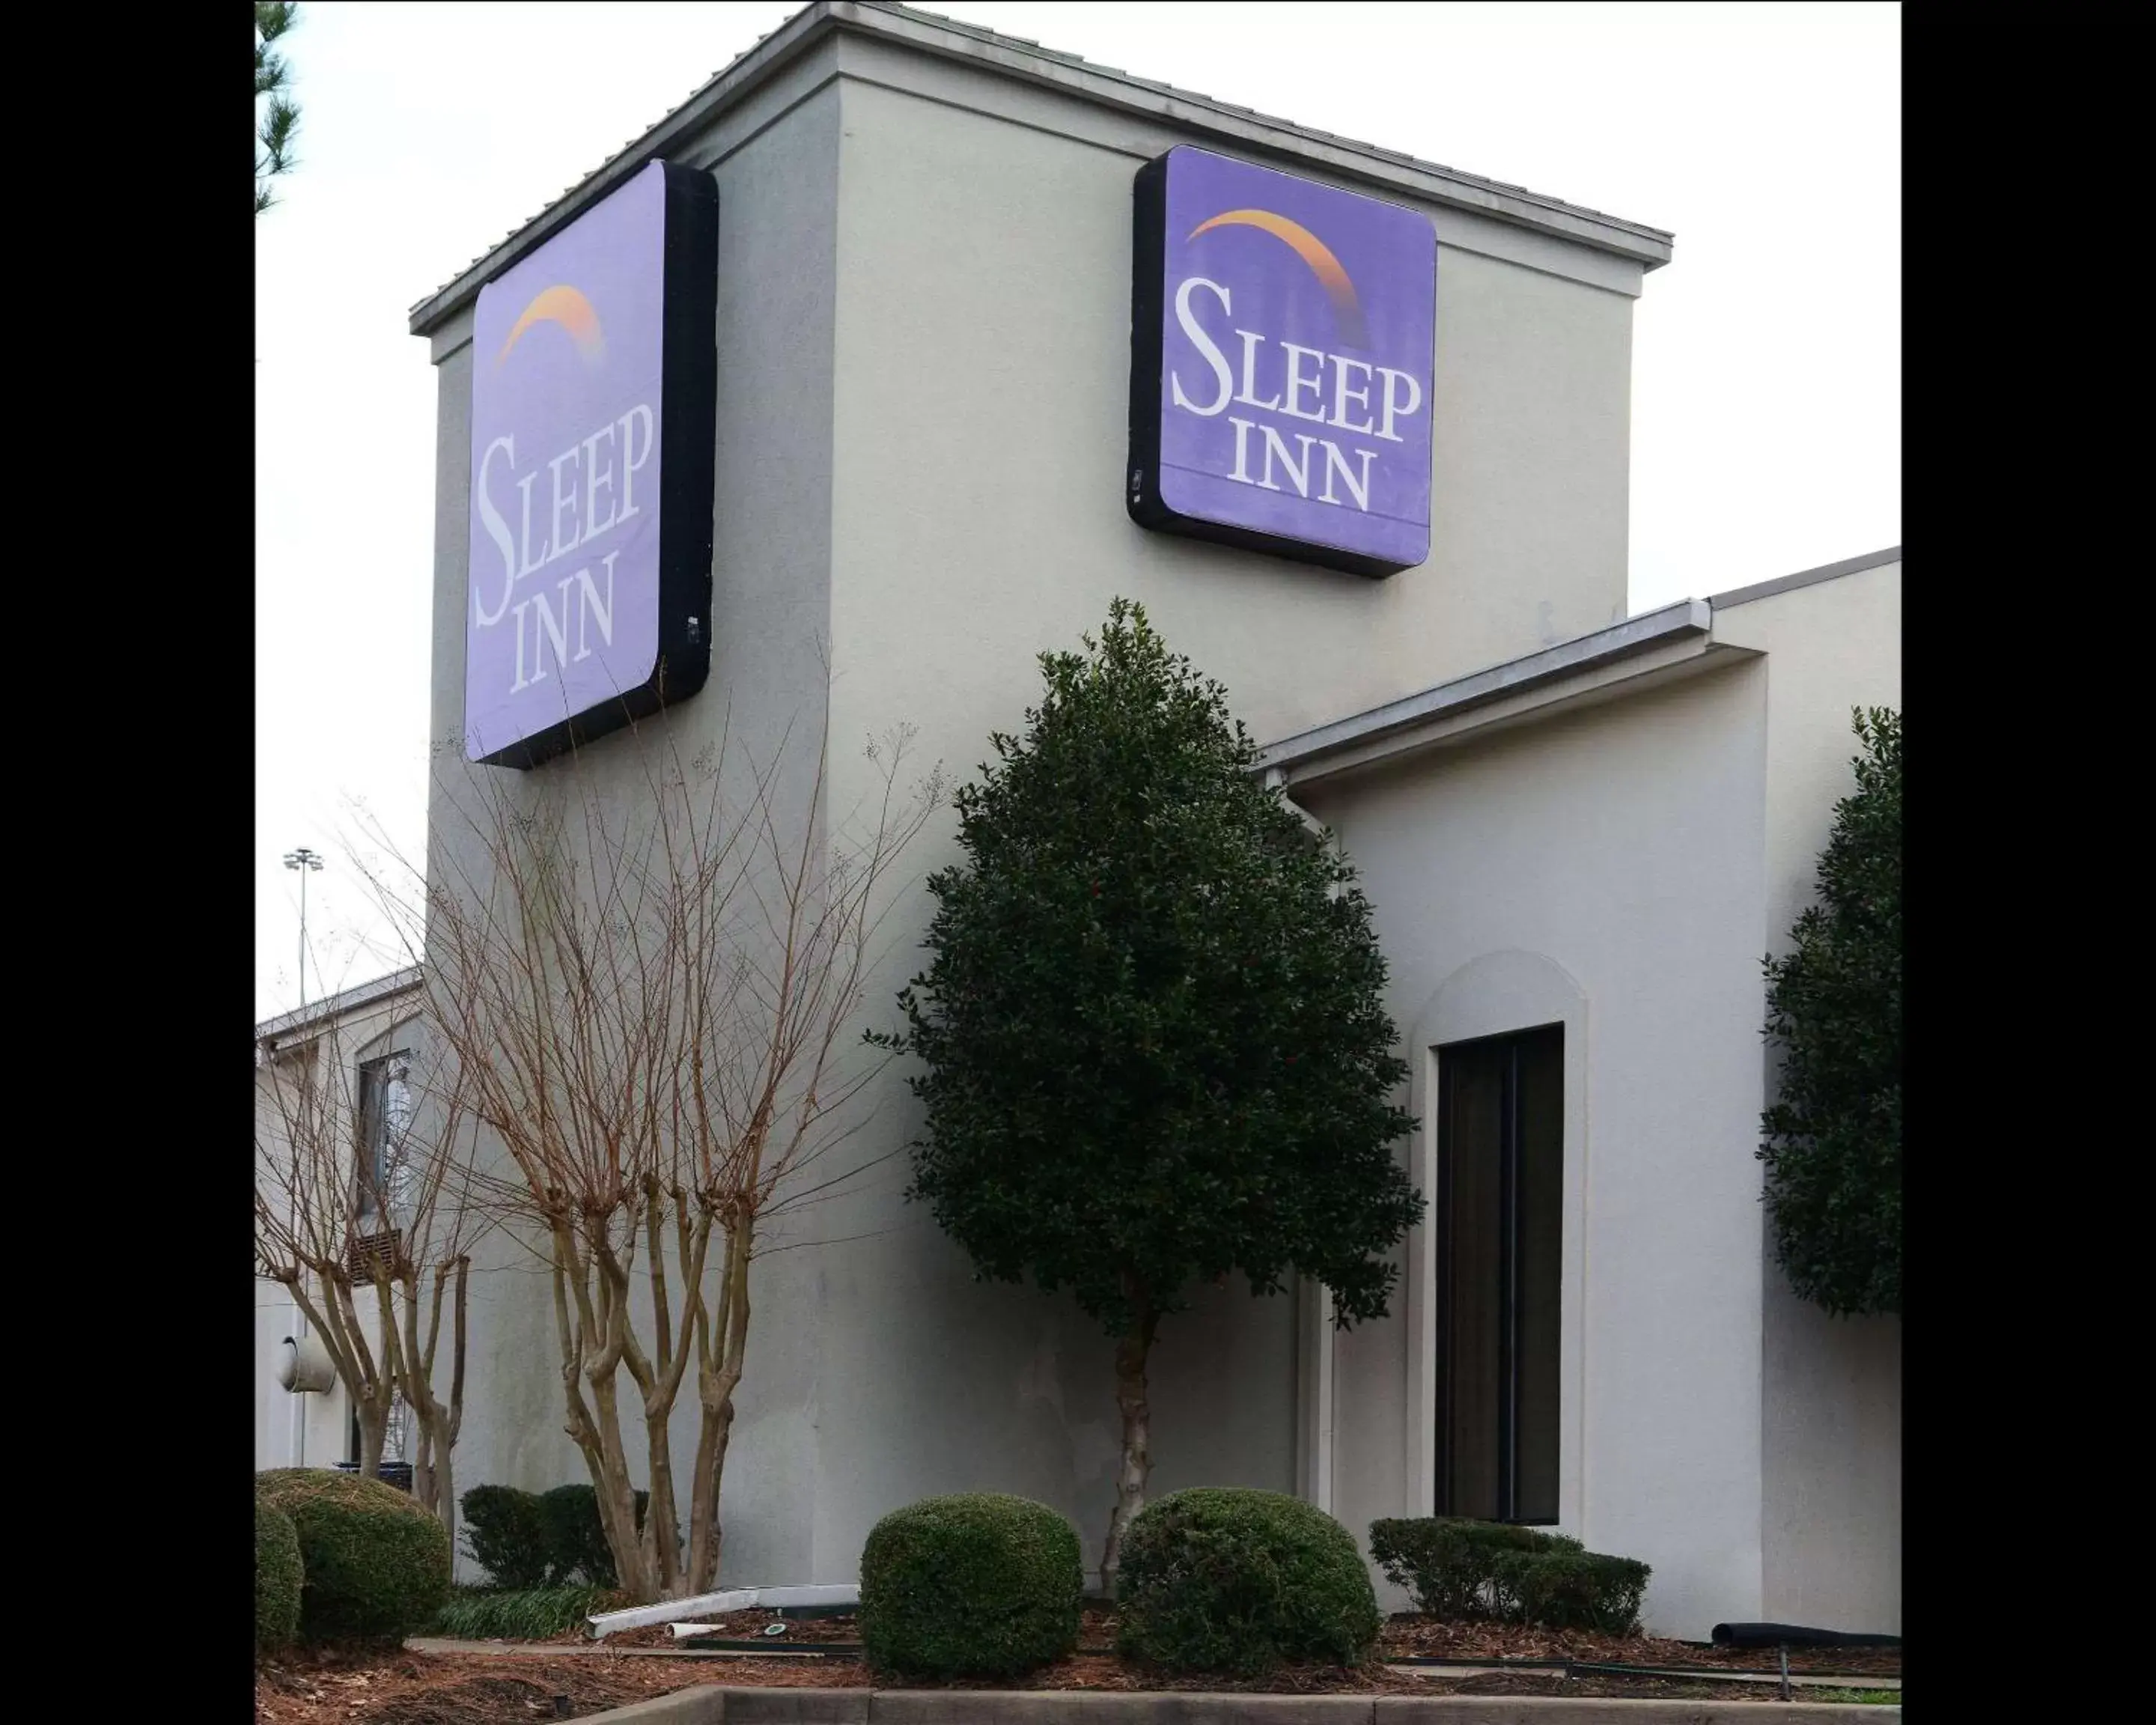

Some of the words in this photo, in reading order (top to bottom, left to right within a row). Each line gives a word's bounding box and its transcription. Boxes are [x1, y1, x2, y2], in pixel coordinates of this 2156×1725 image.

[1172, 277, 1421, 442] SLEEP
[476, 404, 654, 628] SLEEP
[1226, 416, 1378, 511] INN
[509, 550, 620, 695] INN
